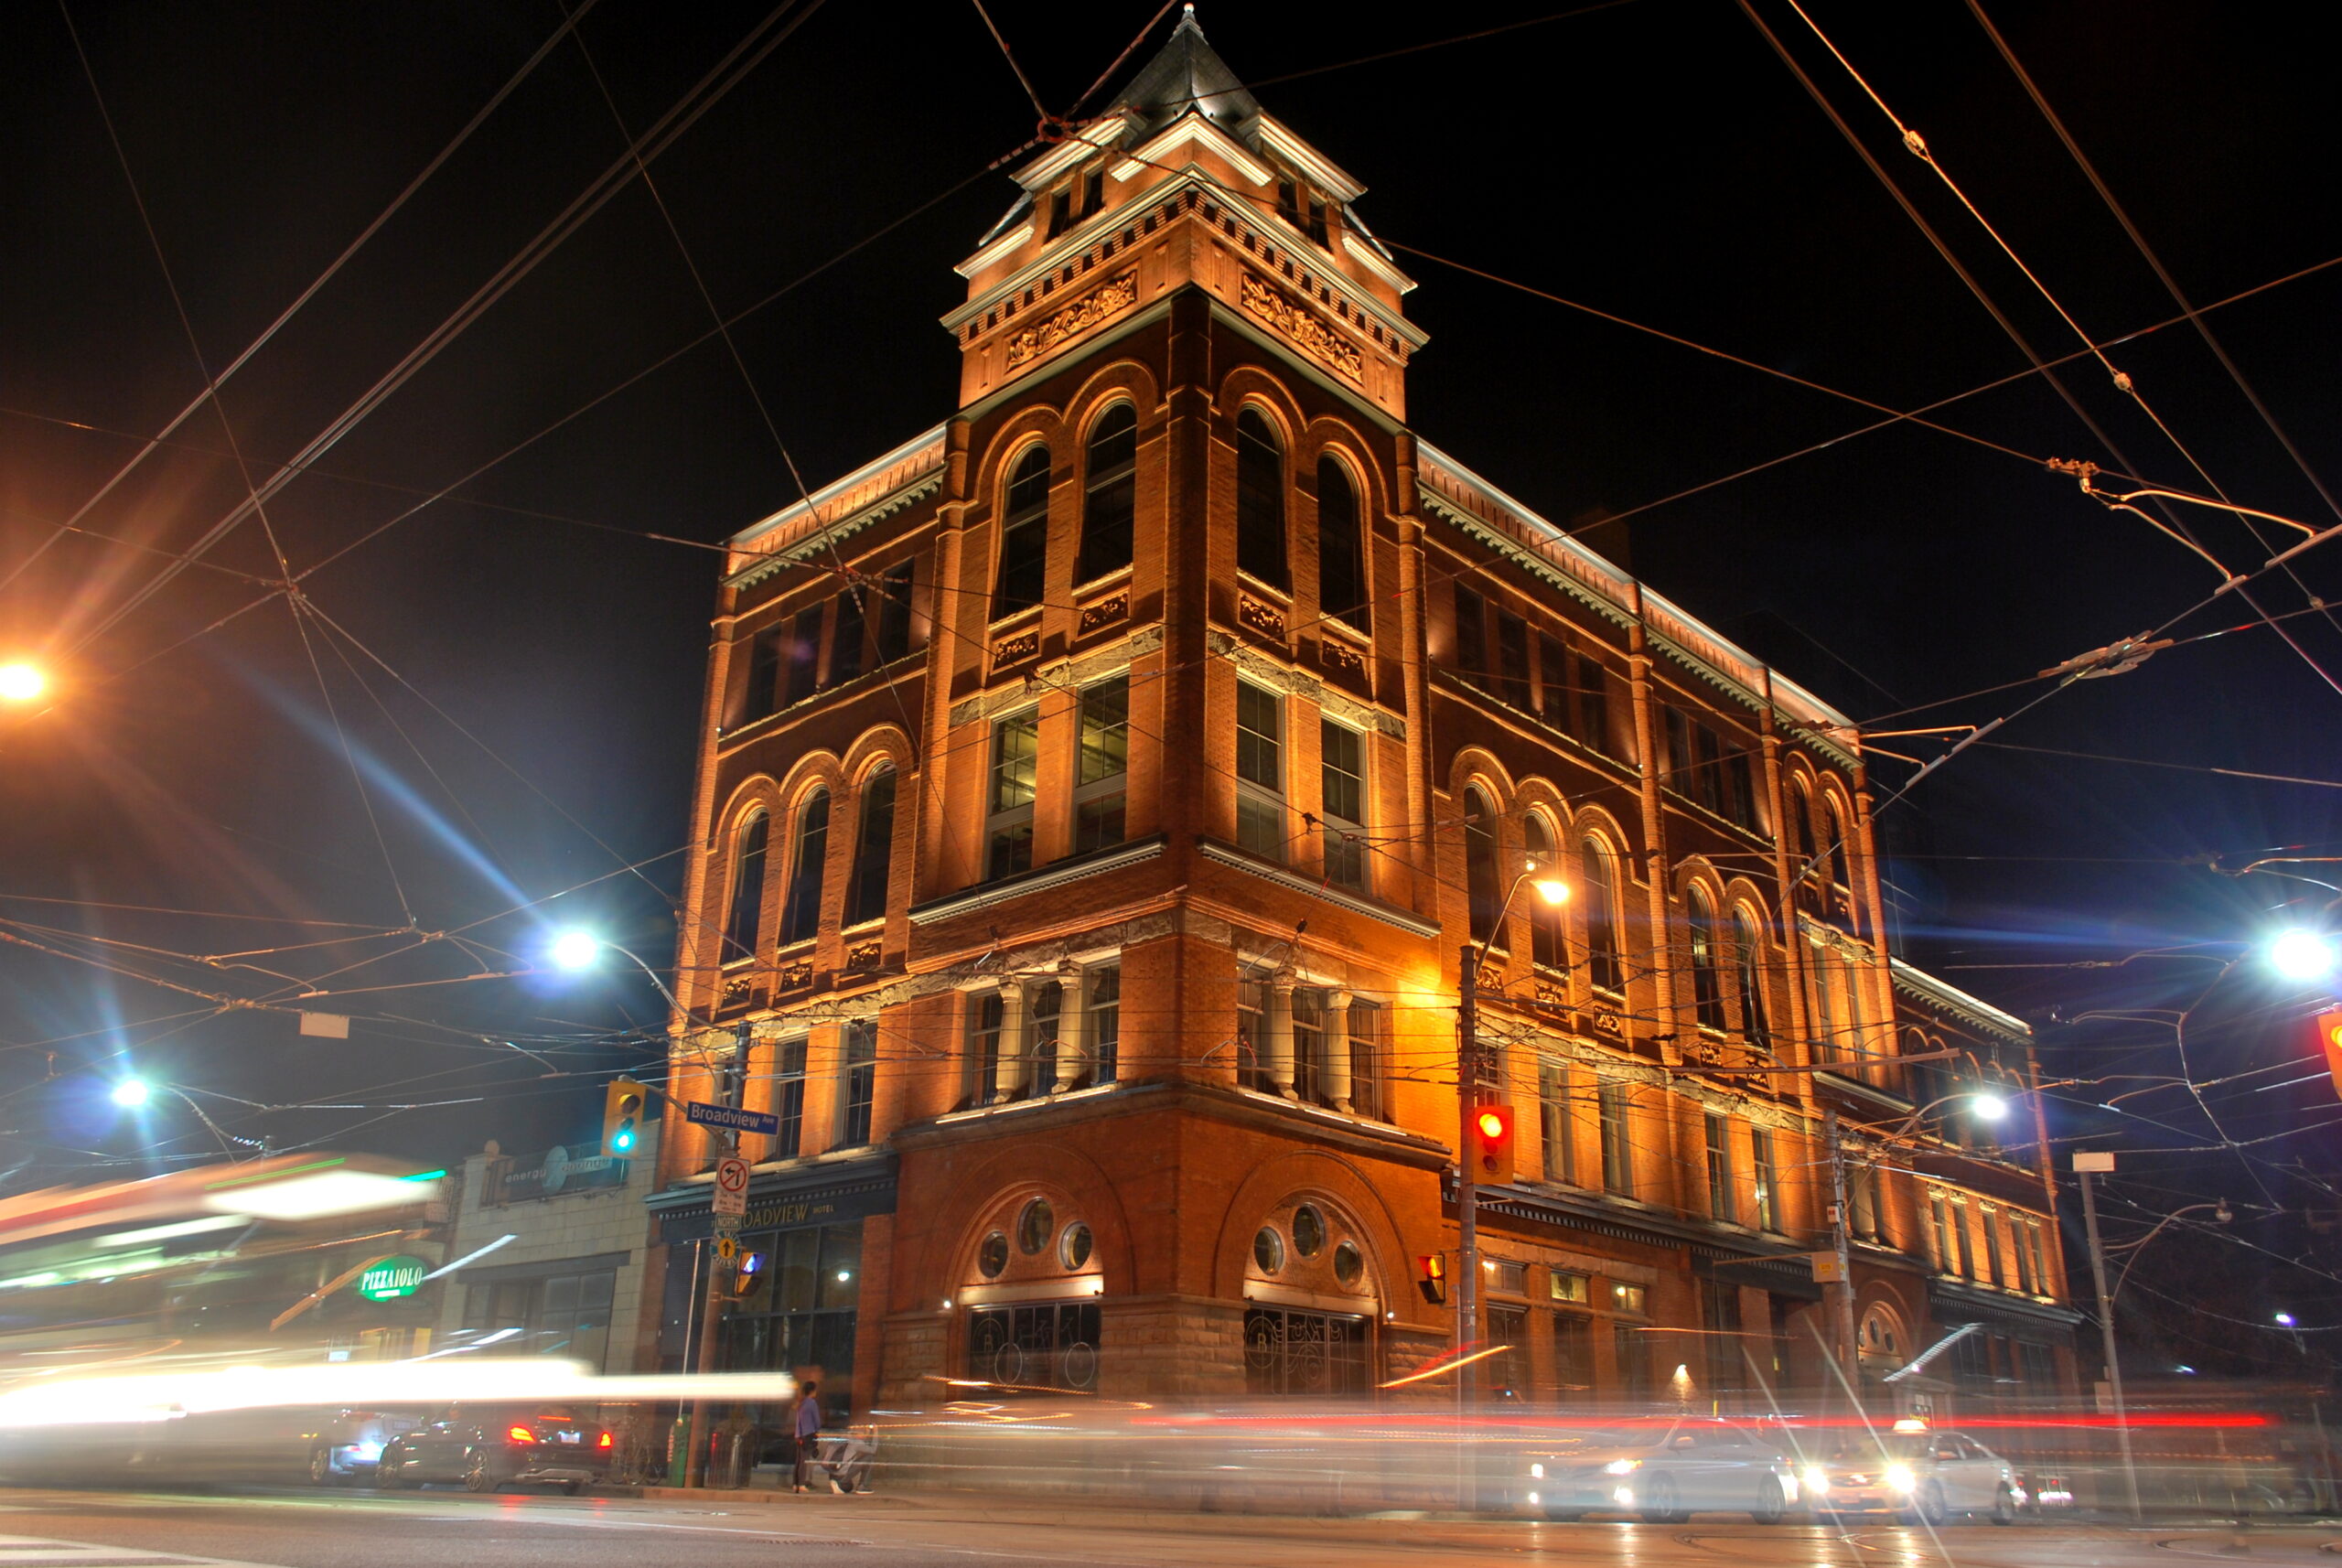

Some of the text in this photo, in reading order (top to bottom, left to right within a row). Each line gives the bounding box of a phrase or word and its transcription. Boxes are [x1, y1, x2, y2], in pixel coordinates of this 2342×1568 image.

[692, 1103, 759, 1128] Broadview
[505, 1168, 547, 1183] energy
[717, 1216, 739, 1229] NORTH
[743, 1203, 809, 1227] OADVIEW
[361, 1266, 422, 1291] PIZZAIOLO
